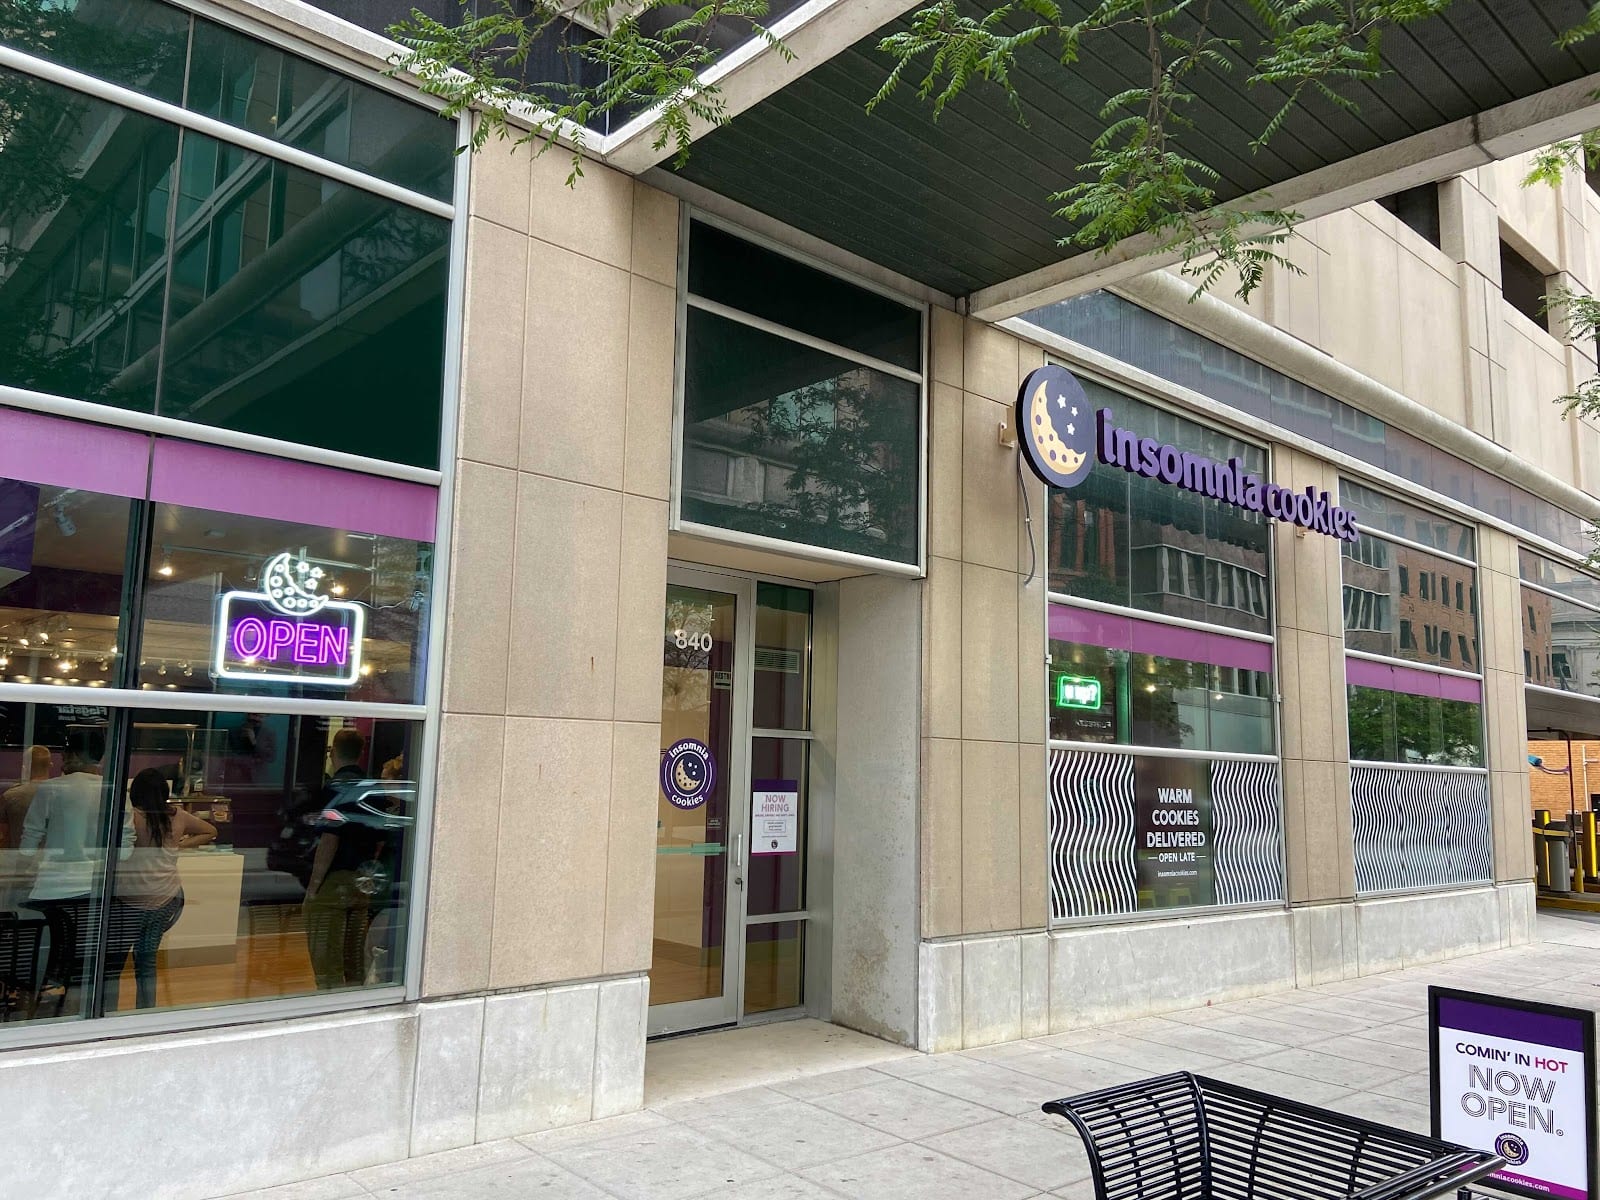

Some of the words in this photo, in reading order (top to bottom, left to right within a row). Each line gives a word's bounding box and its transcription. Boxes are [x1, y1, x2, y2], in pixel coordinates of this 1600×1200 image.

[1096, 407, 1264, 513] insomnia
[1261, 483, 1360, 543] cookies
[234, 617, 348, 665] OPEN
[674, 629, 713, 652] 840
[668, 742, 709, 760] insomnia
[671, 794, 704, 806] cookies
[765, 794, 786, 803] NOW
[1157, 787, 1193, 804] WARM
[761, 803, 789, 812] HIRING
[1151, 809, 1200, 826] COOKIES
[1146, 831, 1206, 848] DELIVERED
[1158, 853, 1178, 863] OPEN
[1179, 852, 1196, 862] LATE
[1455, 1042, 1511, 1062] COMIN'
[1514, 1053, 1530, 1067] IN
[1534, 1056, 1569, 1073] HOT
[1468, 1063, 1557, 1104] NOW
